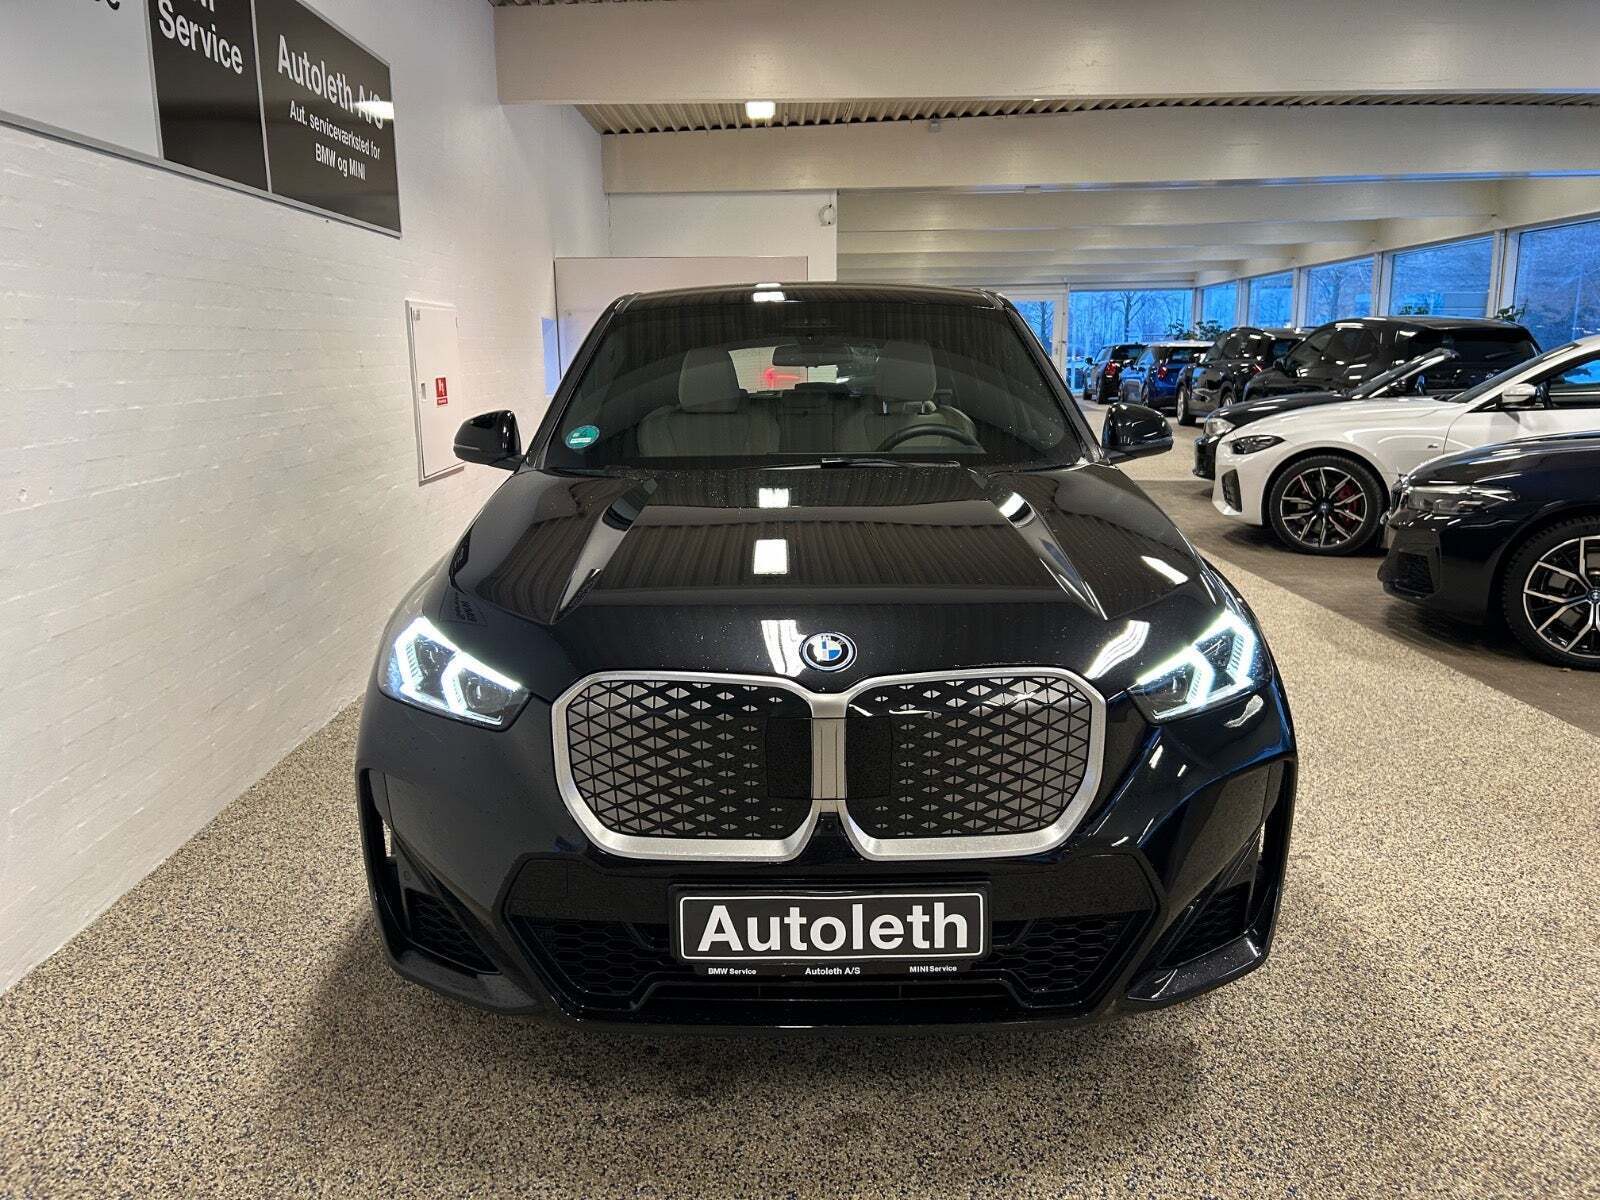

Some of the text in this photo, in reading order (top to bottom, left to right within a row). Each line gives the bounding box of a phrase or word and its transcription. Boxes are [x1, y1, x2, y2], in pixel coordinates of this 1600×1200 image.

[158, 0, 243, 74] Service
[278, 34, 384, 129] Autoleth A/S
[290, 100, 380, 159] Aut. serviceværksted for
[315, 143, 366, 180] BMW og MINI
[697, 902, 968, 952] Autoleth
[804, 966, 861, 975] Autoleth A/S
